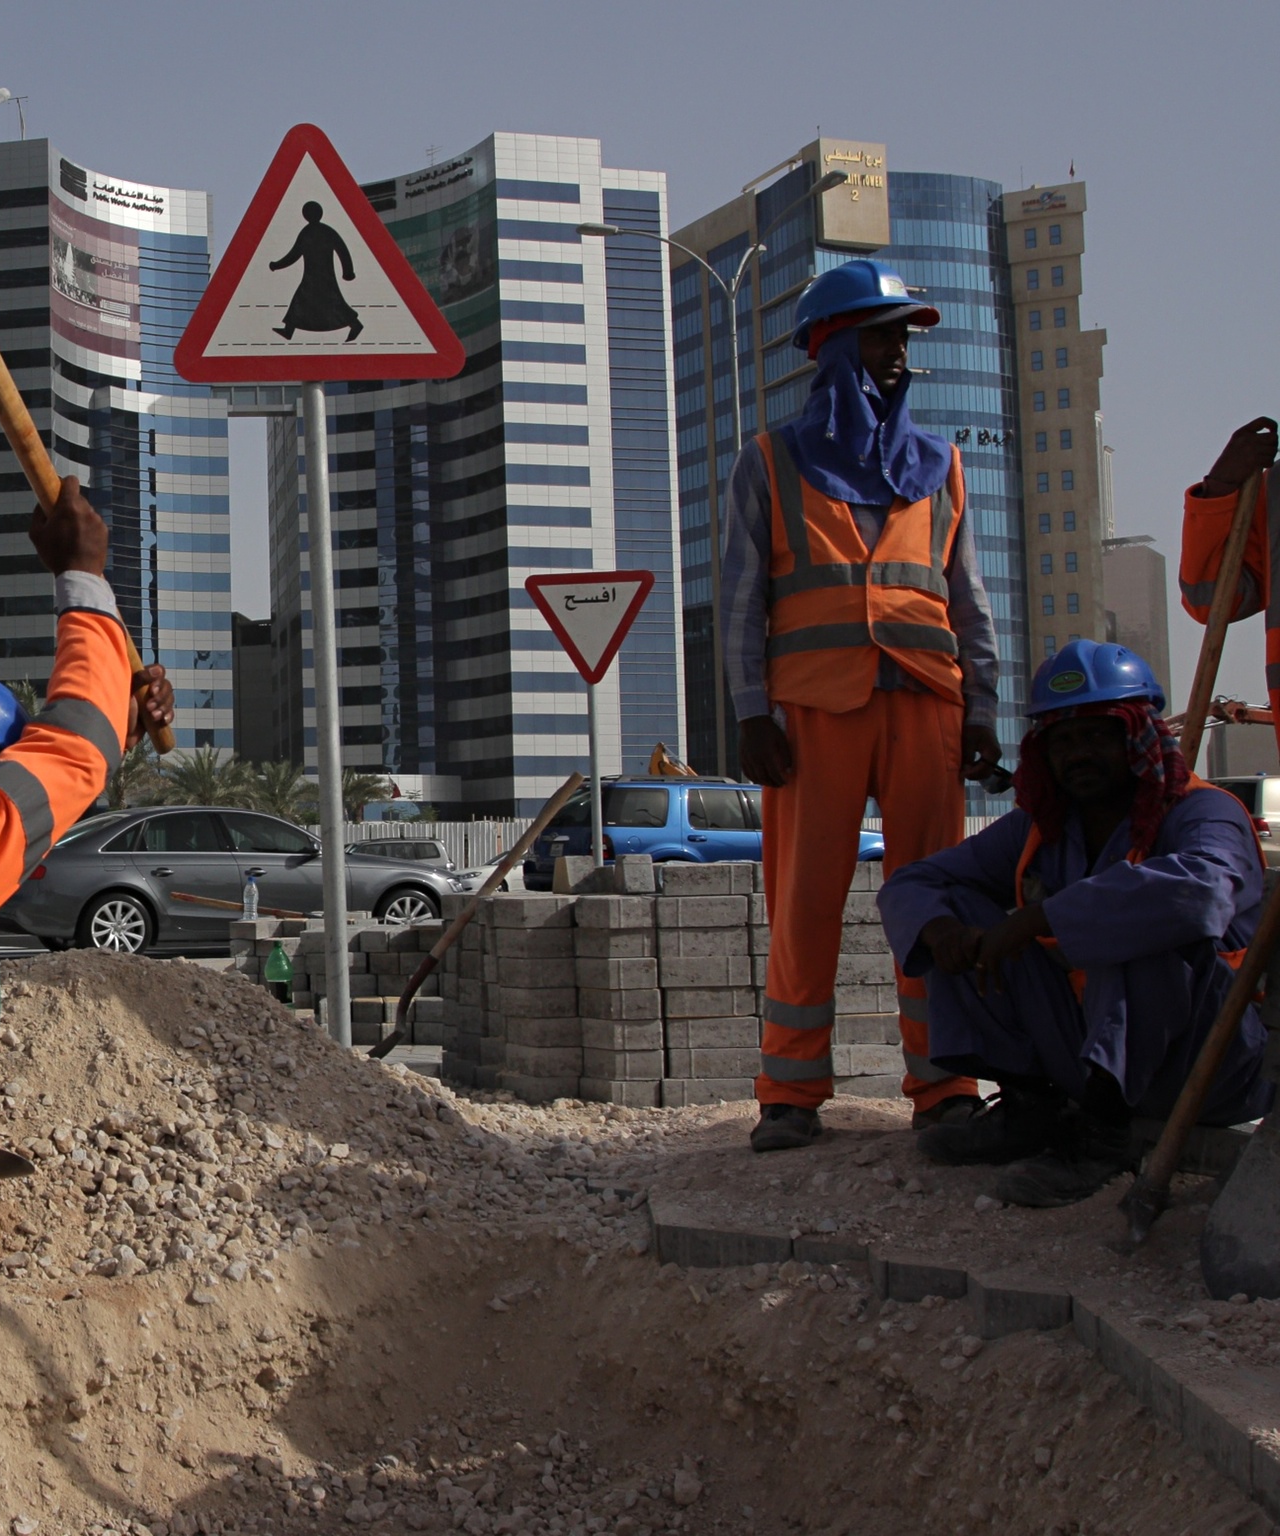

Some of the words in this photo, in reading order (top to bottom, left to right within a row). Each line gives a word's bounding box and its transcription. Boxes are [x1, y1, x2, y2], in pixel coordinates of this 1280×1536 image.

[824, 149, 863, 165] السليطي
[865, 154, 882, 168] برج
[861, 174, 882, 187] TOWER
[93, 191, 109, 202] Public
[111, 197, 130, 207] Works
[132, 202, 164, 215] Authority
[851, 190, 859, 201] 2
[564, 587, 616, 611] افسح
